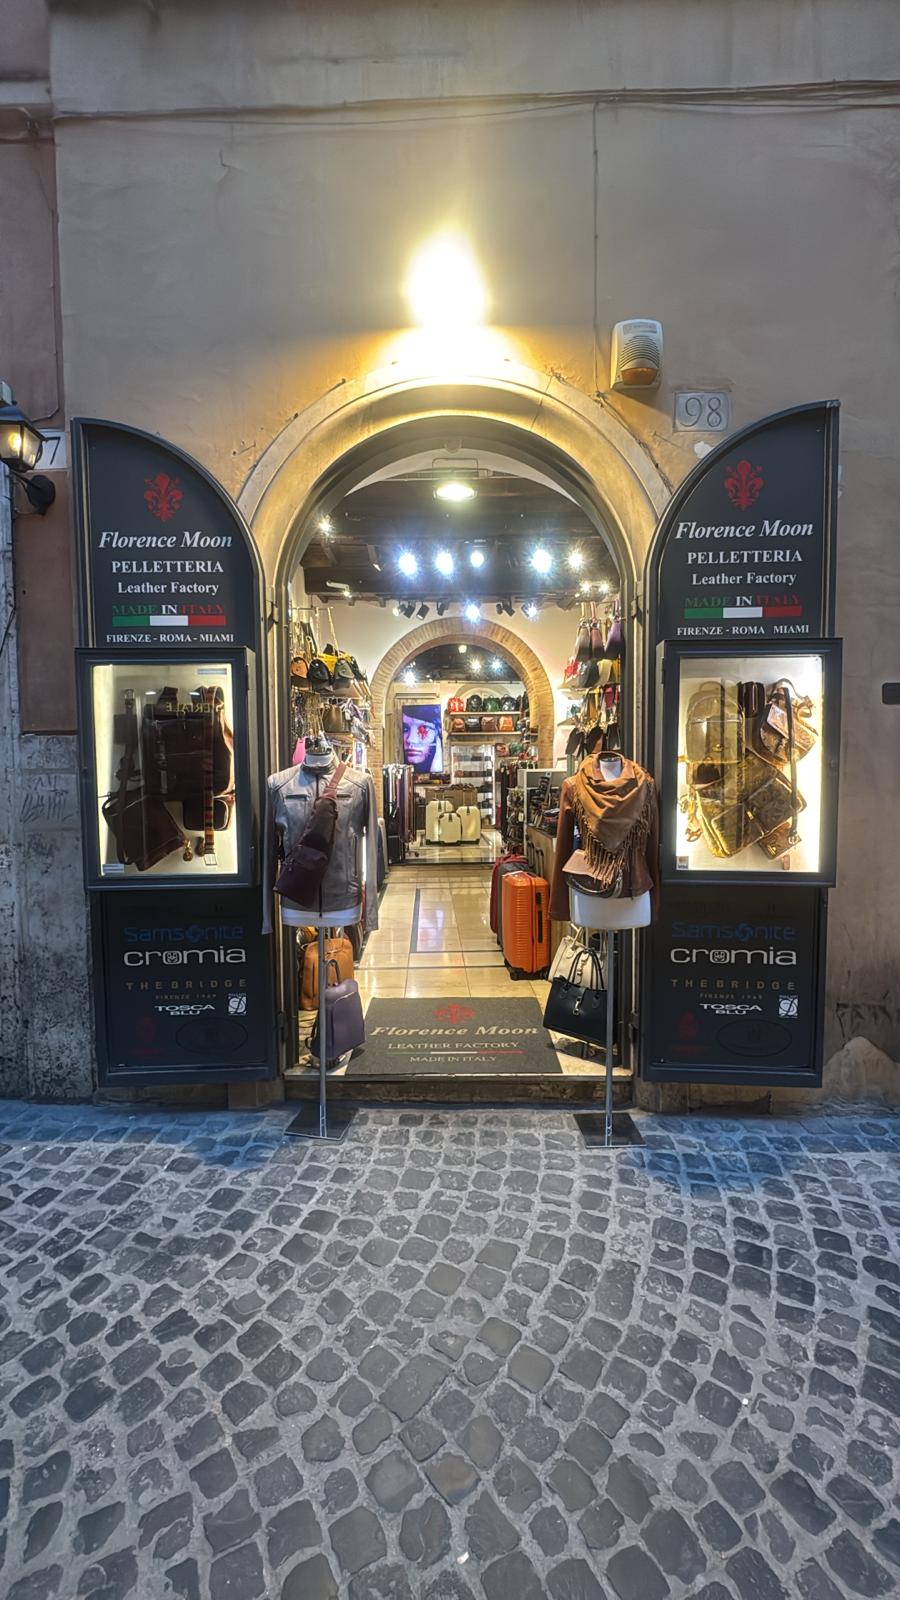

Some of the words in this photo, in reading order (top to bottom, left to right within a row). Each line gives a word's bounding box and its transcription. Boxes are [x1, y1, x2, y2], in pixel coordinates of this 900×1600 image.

[679, 396, 722, 427] 98
[674, 521, 755, 540] Florence
[759, 519, 814, 537] Moon
[99, 531, 177, 549] Florence
[181, 531, 232, 549] Moon
[687, 550, 803, 565] PELLETTERIA
[111, 560, 224, 573] PELLETTERIA
[692, 573, 743, 585] Leather
[746, 572, 797, 586] Factory
[118, 582, 167, 593] Leather
[170, 582, 219, 596] Factory
[684, 597, 732, 608] MADE
[735, 596, 753, 607] IN
[755, 594, 801, 606] ITALY
[112, 604, 158, 614] MADE
[161, 604, 178, 614] IN
[181, 604, 224, 614] ITALY
[677, 626, 724, 636] FIRENZE
[732, 625, 765, 635] ROMA
[773, 624, 809, 634] MIAMI
[106, 634, 151, 643] FIRENZE
[159, 633, 192, 643] ROMA
[199, 633, 234, 643] MIAMI
[123, 924, 244, 944] Samsonite
[671, 921, 796, 942] Samsonite
[123, 946, 246, 967] cromia
[670, 946, 797, 966] cromia
[154, 1004, 216, 1012] TOSCA
[699, 1003, 763, 1012] TOSCA
[369, 1026, 469, 1036] Florence
[475, 1025, 539, 1036] Moon
[455, 1041, 520, 1049] FACTORY
